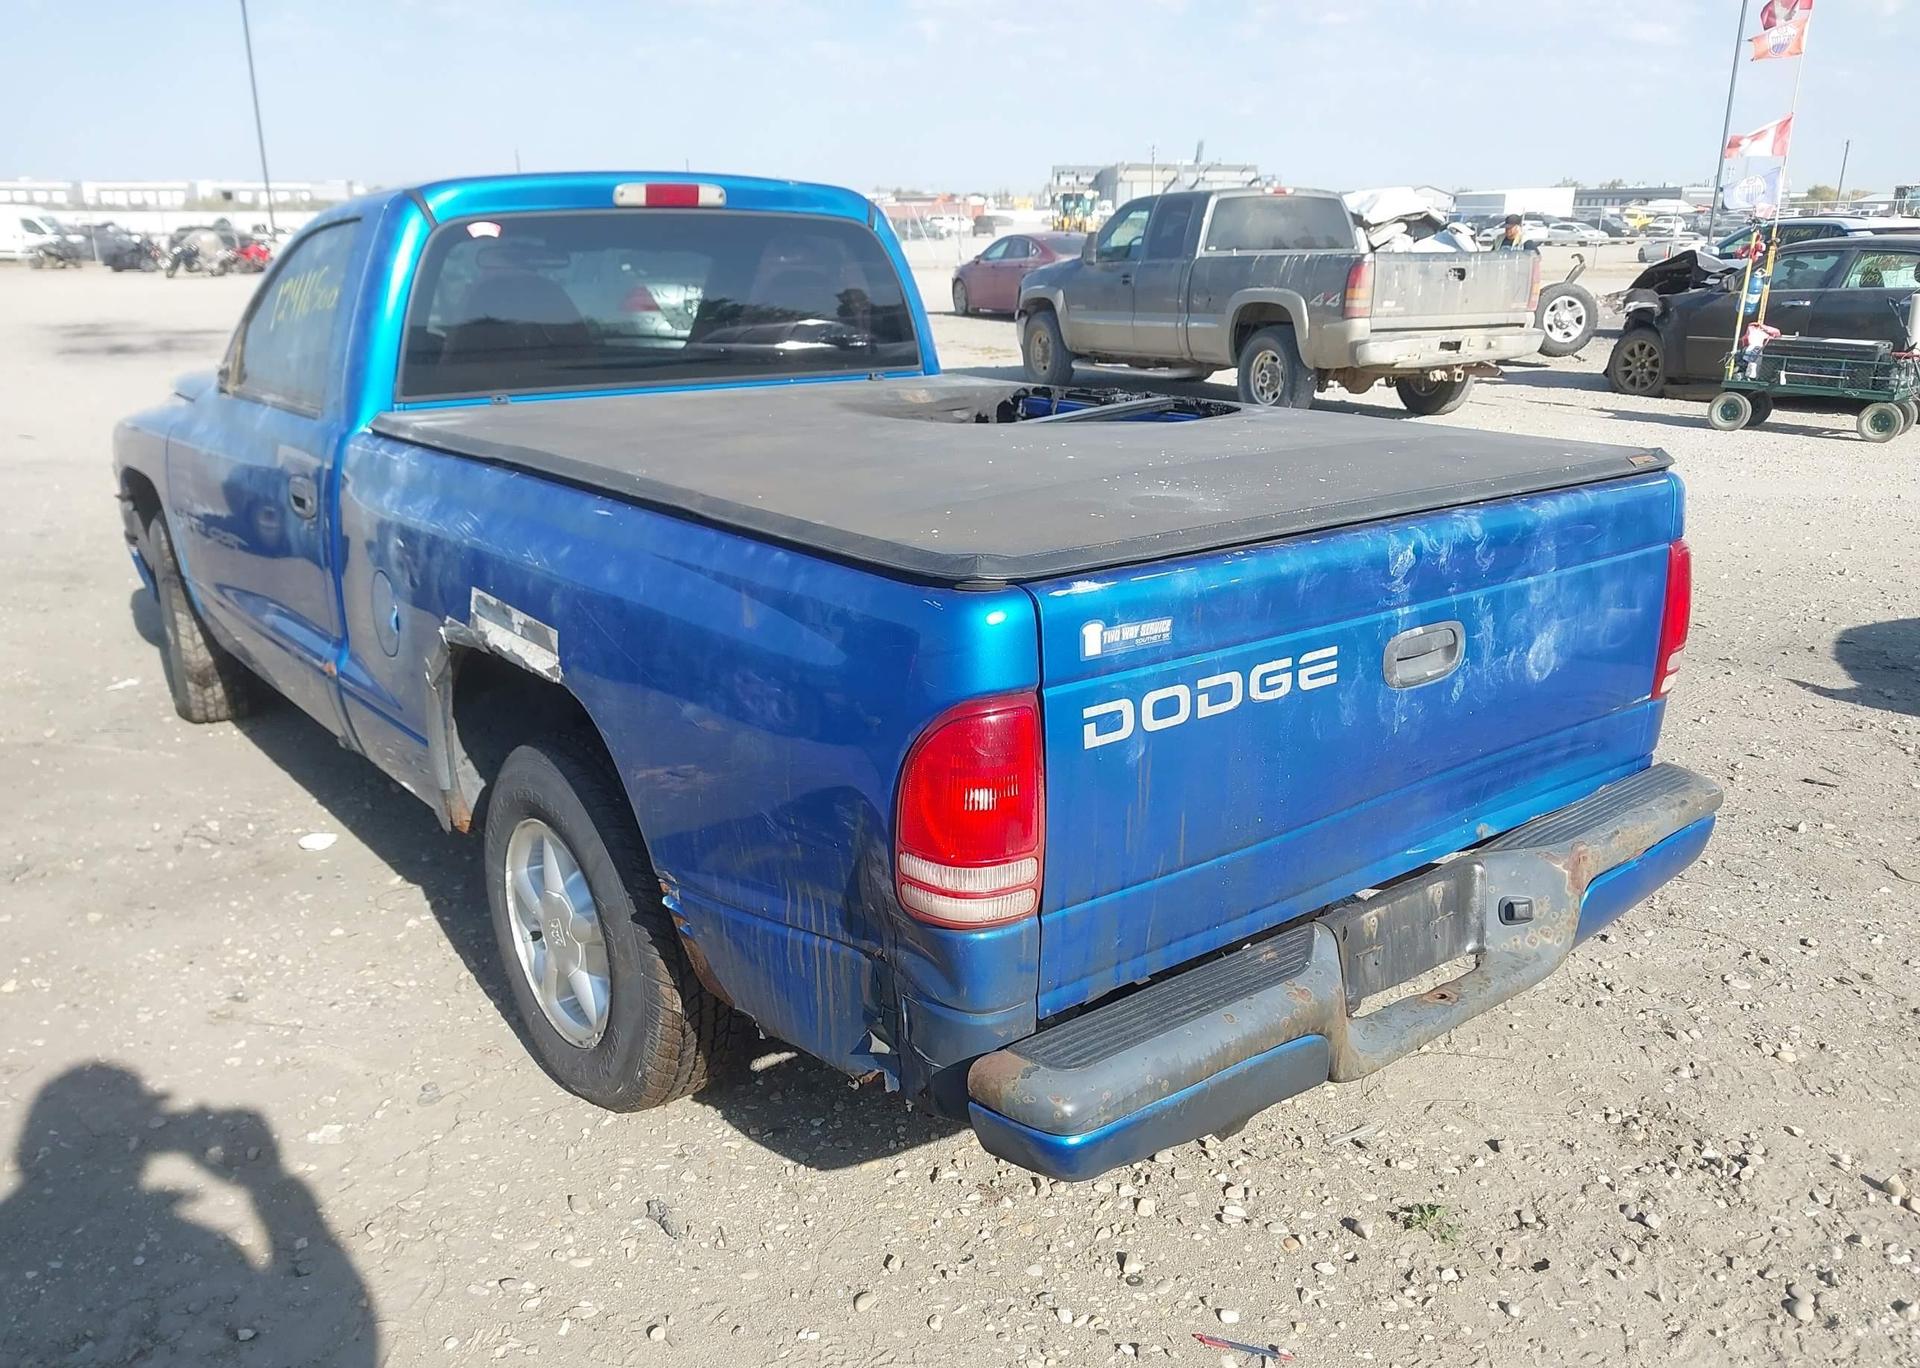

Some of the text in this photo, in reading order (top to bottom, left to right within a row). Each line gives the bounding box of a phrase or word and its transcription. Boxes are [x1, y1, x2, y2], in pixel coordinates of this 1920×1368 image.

[1103, 619, 1172, 644] TWO WAY SERVICE
[1082, 645, 1338, 750] DODGE
